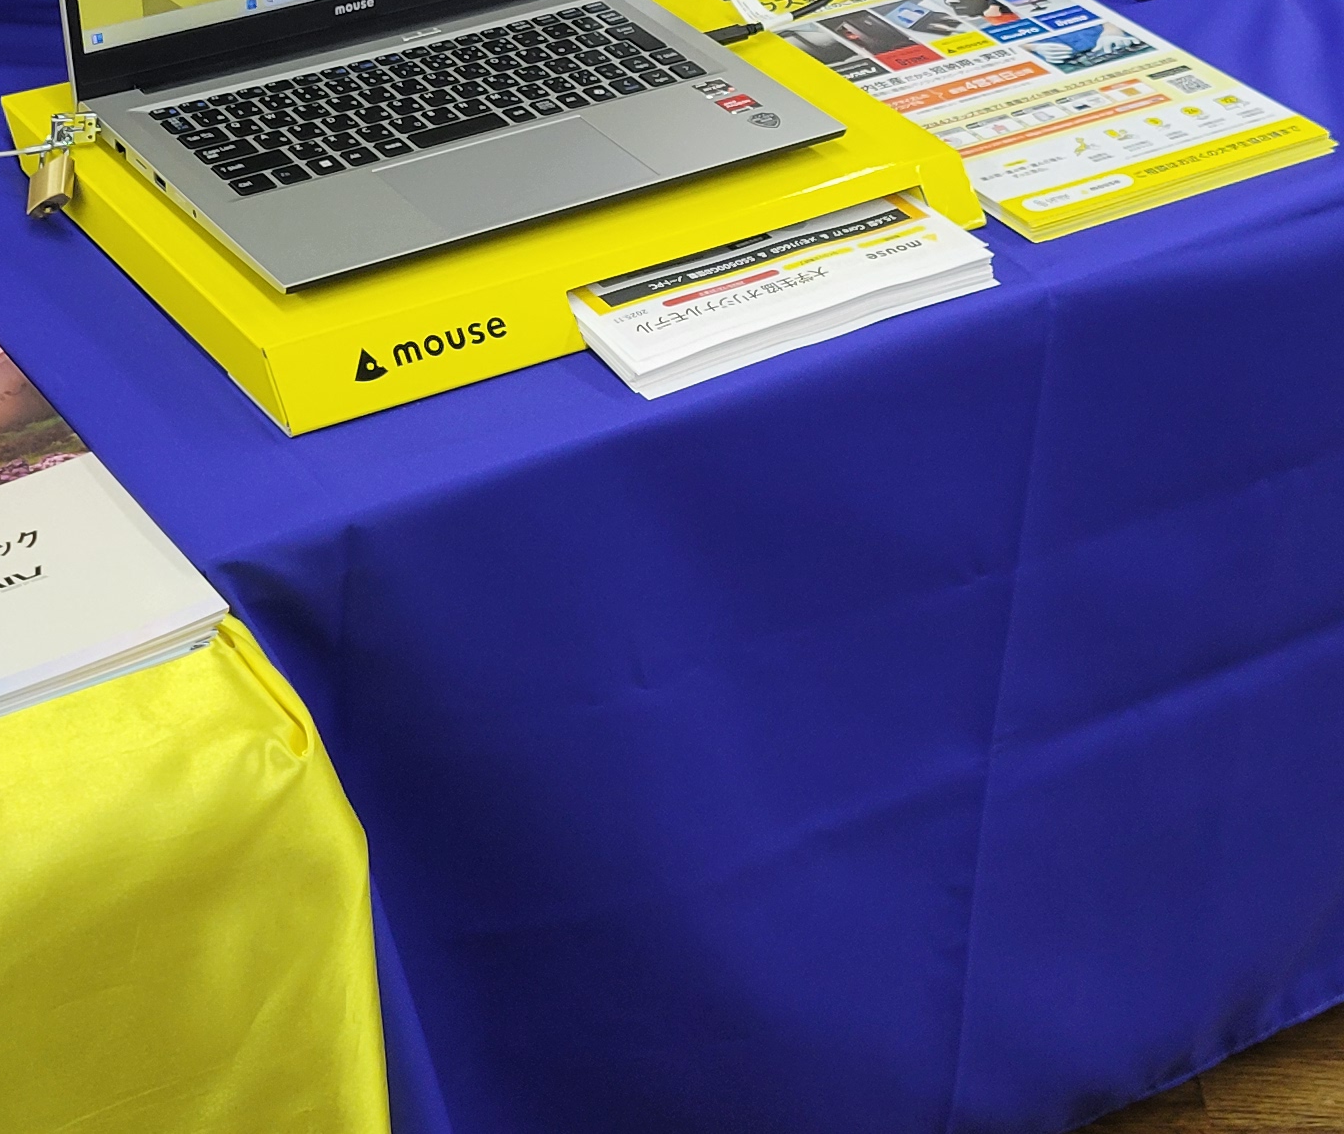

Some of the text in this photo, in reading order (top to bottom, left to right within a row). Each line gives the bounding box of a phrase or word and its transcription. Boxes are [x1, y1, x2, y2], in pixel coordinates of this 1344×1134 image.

[1135, 124, 1301, 179] ご相談はお近くの大学生協店舗まで
[839, 222, 867, 235] Core
[865, 239, 923, 262] mouse
[613, 308, 649, 326] 2025.11
